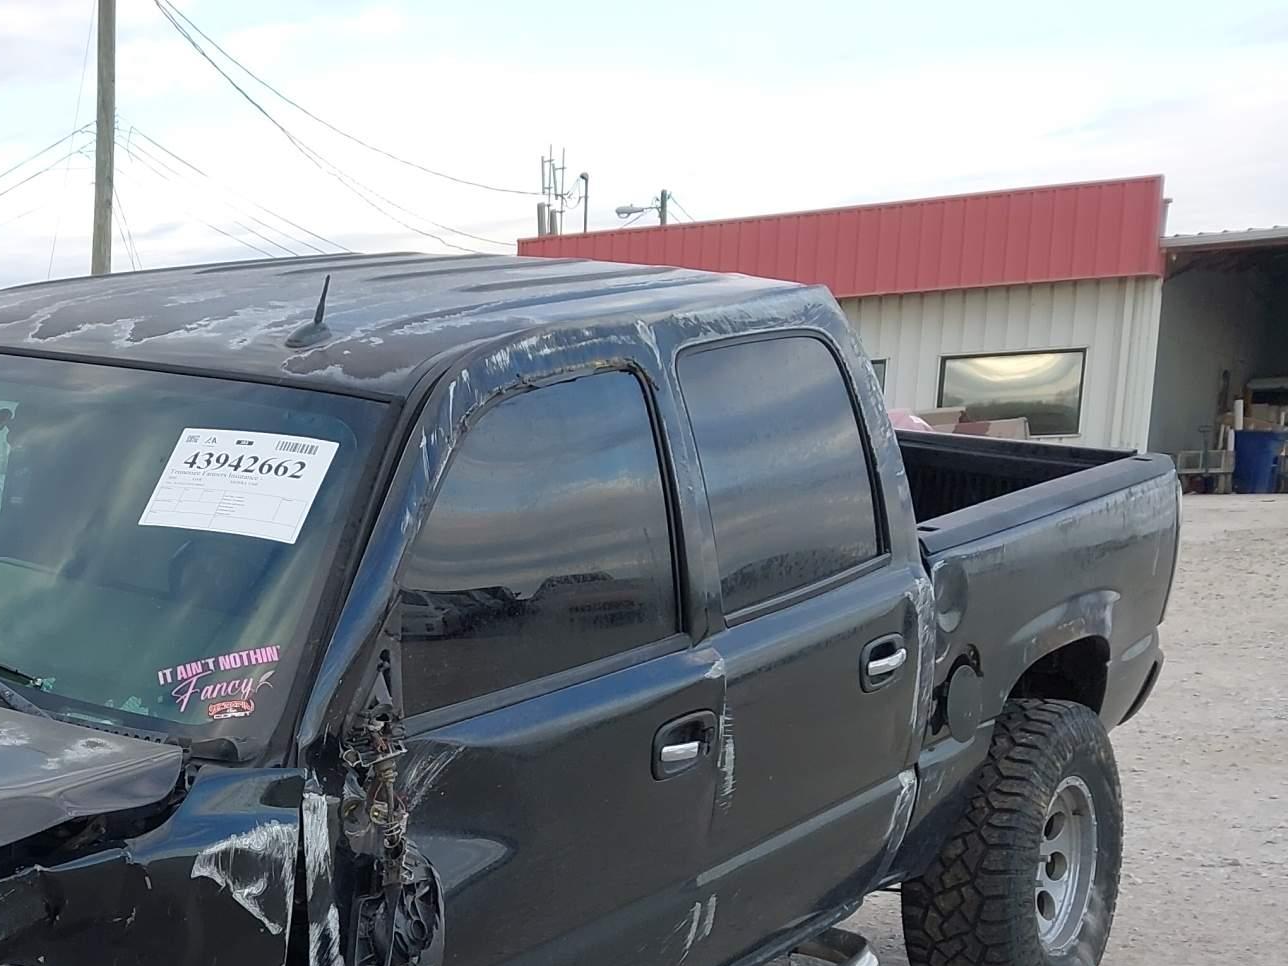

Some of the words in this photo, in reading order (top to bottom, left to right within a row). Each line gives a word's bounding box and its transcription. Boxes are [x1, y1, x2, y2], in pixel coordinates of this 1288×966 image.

[183, 450, 307, 480] 43942662
[158, 668, 173, 686] IT
[176, 658, 215, 680] AIN'T
[218, 645, 281, 671] NOTHIN'
[171, 671, 254, 713] Fancy
